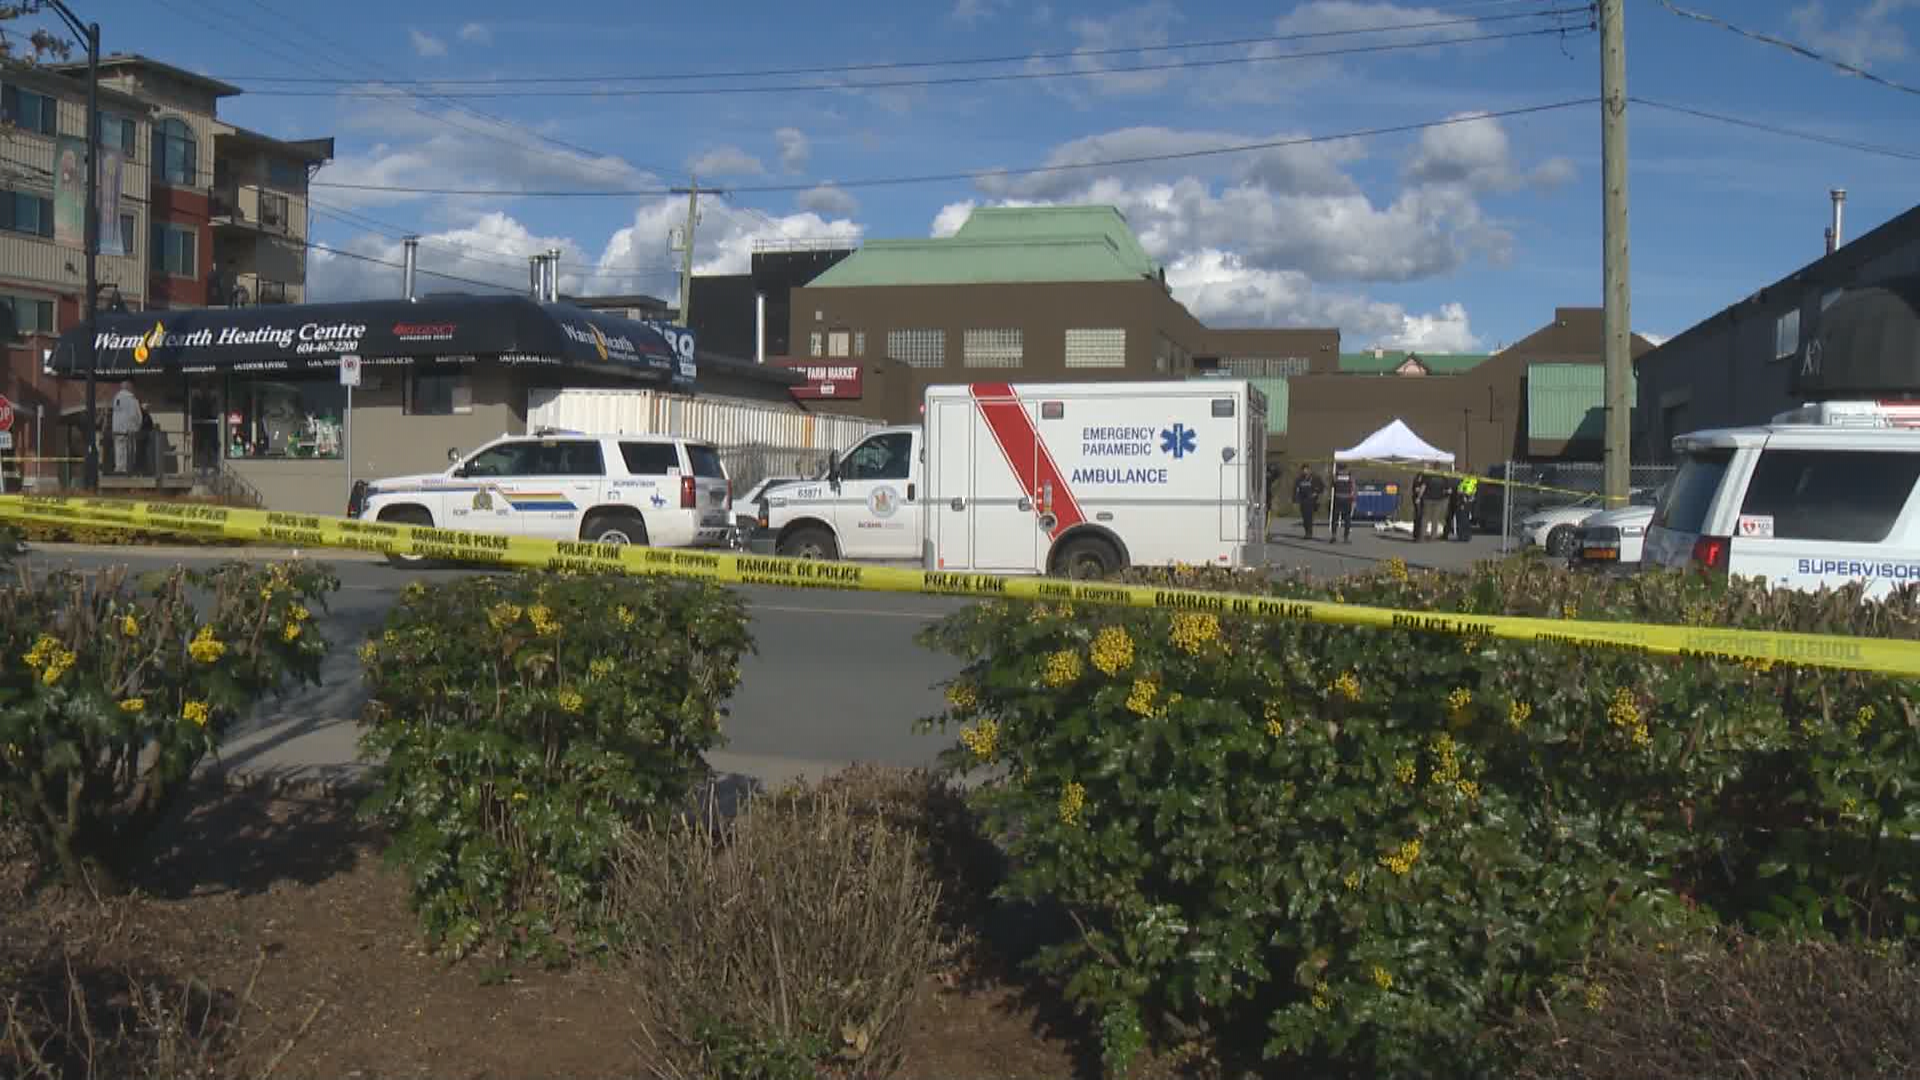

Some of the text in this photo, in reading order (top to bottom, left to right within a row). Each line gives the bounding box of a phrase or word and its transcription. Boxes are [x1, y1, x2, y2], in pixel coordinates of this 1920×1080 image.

[94, 333, 146, 350] Warm
[216, 326, 296, 348] Heating
[298, 323, 366, 341] Centre
[807, 366, 827, 380] FARM
[828, 366, 858, 380] MARKET
[1083, 427, 1155, 440] EMERGENCY
[1083, 443, 1152, 456] PARAMEDIC
[1071, 469, 1168, 484] AMBULANCE
[474, 535, 509, 550] POLICE
[557, 541, 592, 558] POLICE
[737, 558, 793, 576] BARRAGE
[817, 564, 862, 581] POLICE
[1798, 559, 1920, 580] SUPERVISOR
[924, 573, 1005, 593] POLICE LINE
[1155, 591, 1225, 611] BARRAGE
[1258, 601, 1313, 619] POLICE
[1393, 614, 1496, 637] POLICE LINE
